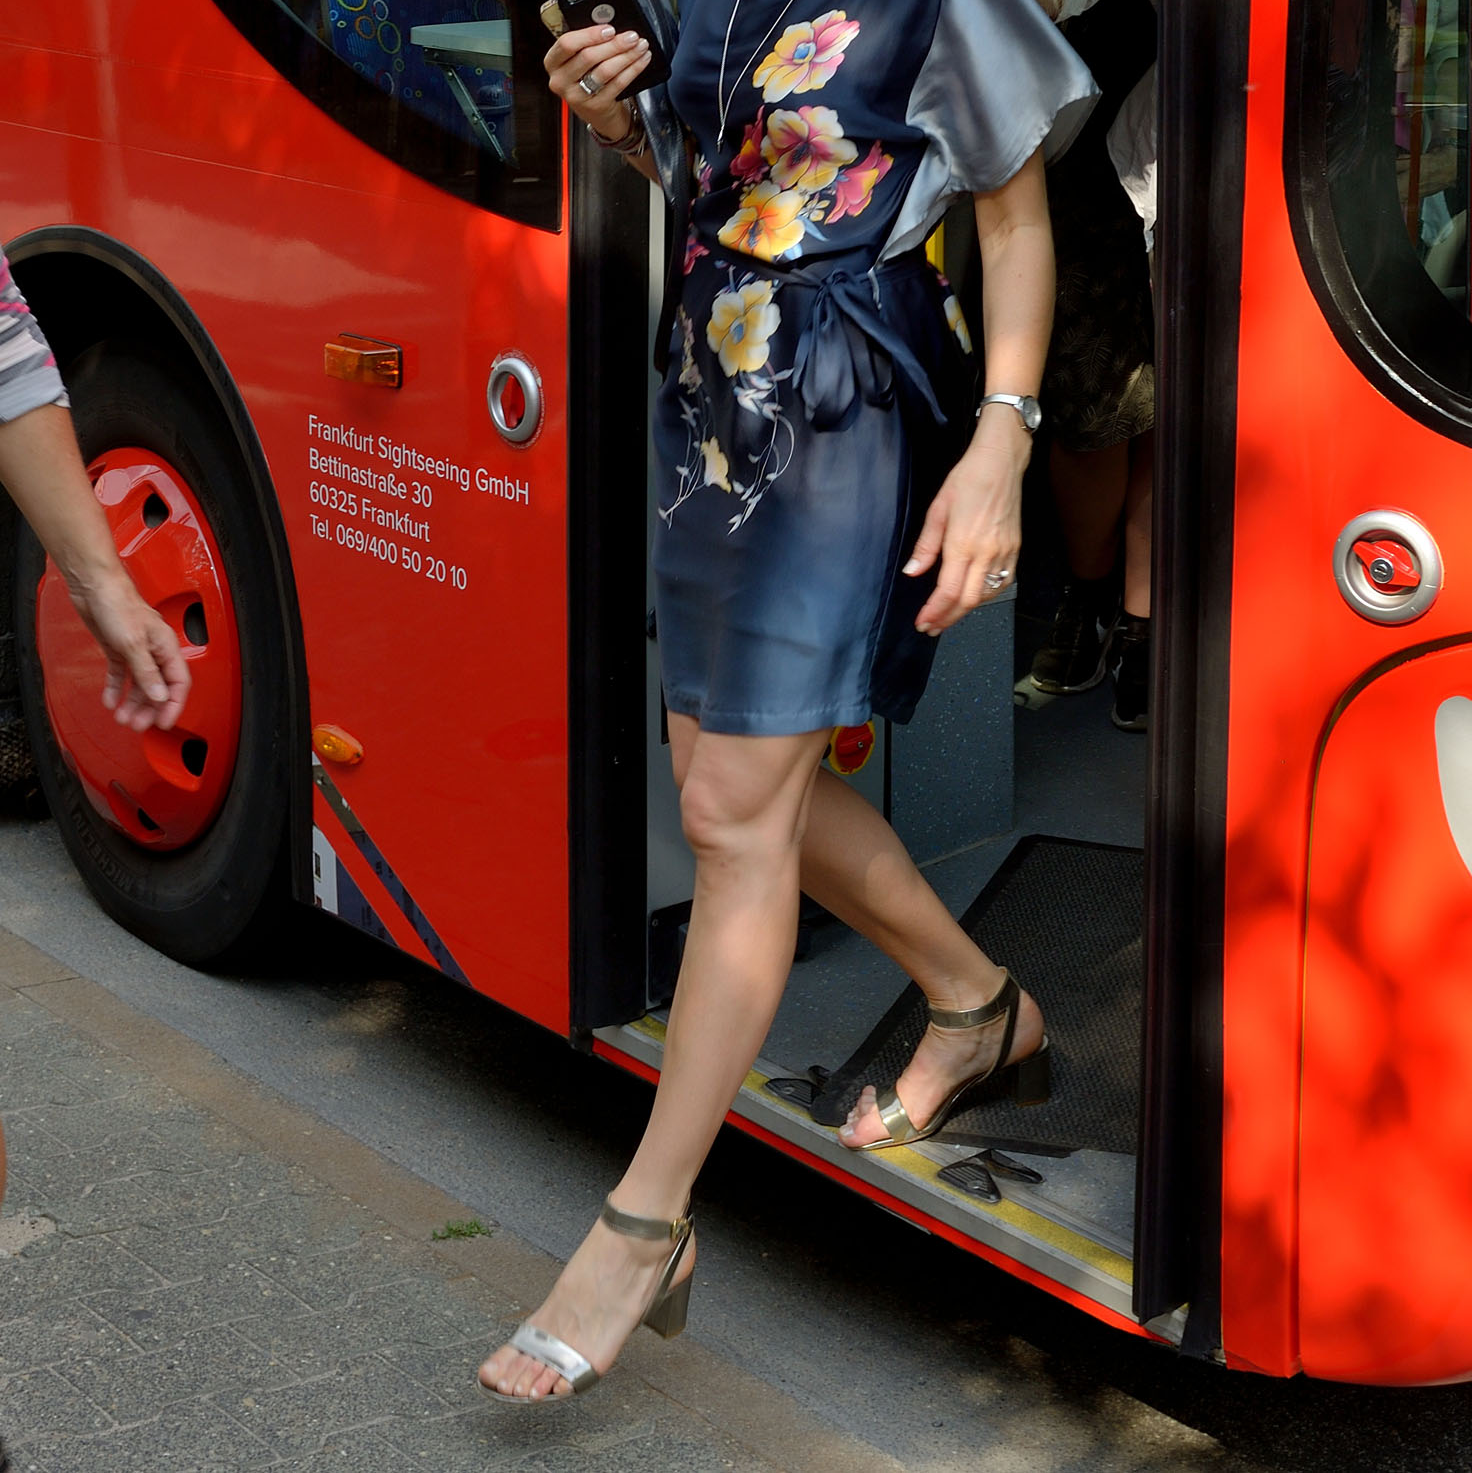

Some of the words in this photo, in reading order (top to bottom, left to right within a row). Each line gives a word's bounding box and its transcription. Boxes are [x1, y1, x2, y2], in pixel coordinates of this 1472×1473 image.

[308, 414, 374, 456] Frankfurt
[378, 436, 471, 492] Sightseeing
[475, 469, 530, 506] GmbH
[309, 448, 407, 500] Bettinastraße
[411, 481, 433, 508] 30
[309, 482, 357, 517] 60325
[361, 498, 431, 543] Frankfurt
[309, 513, 333, 541] Tel.
[336, 523, 398, 565] 069/400
[401, 547, 422, 574] 50
[425, 556, 446, 584] 20
[449, 566, 468, 591] 10
